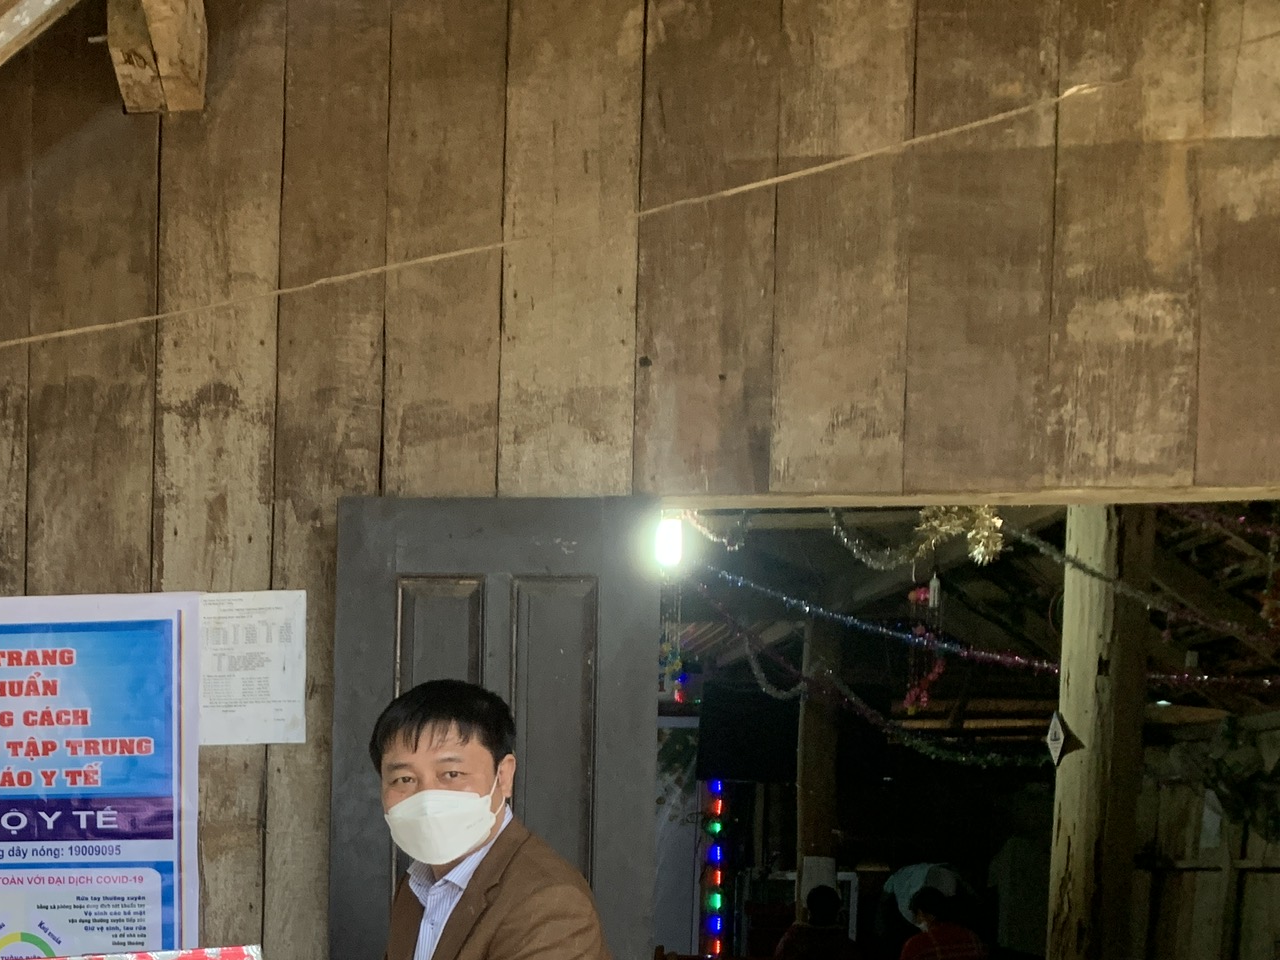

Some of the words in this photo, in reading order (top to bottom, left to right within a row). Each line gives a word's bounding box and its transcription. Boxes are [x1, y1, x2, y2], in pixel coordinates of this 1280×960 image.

[23, 708, 88, 726] CÁCH
[7, 736, 57, 762] TẬP
[66, 738, 153, 756] TRUNG
[41, 770, 56, 787] Y
[65, 762, 101, 786] TẾ
[38, 811, 62, 830] Y
[72, 806, 118, 829] TẾ
[8, 846, 28, 859] dây
[32, 845, 64, 859] nóng:
[68, 845, 121, 856] 19009095
[27, 874, 45, 885] VỚI
[48, 876, 65, 886] ĐẠI
[68, 876, 92, 886] DỊCH
[96, 875, 144, 884] COVID-19
